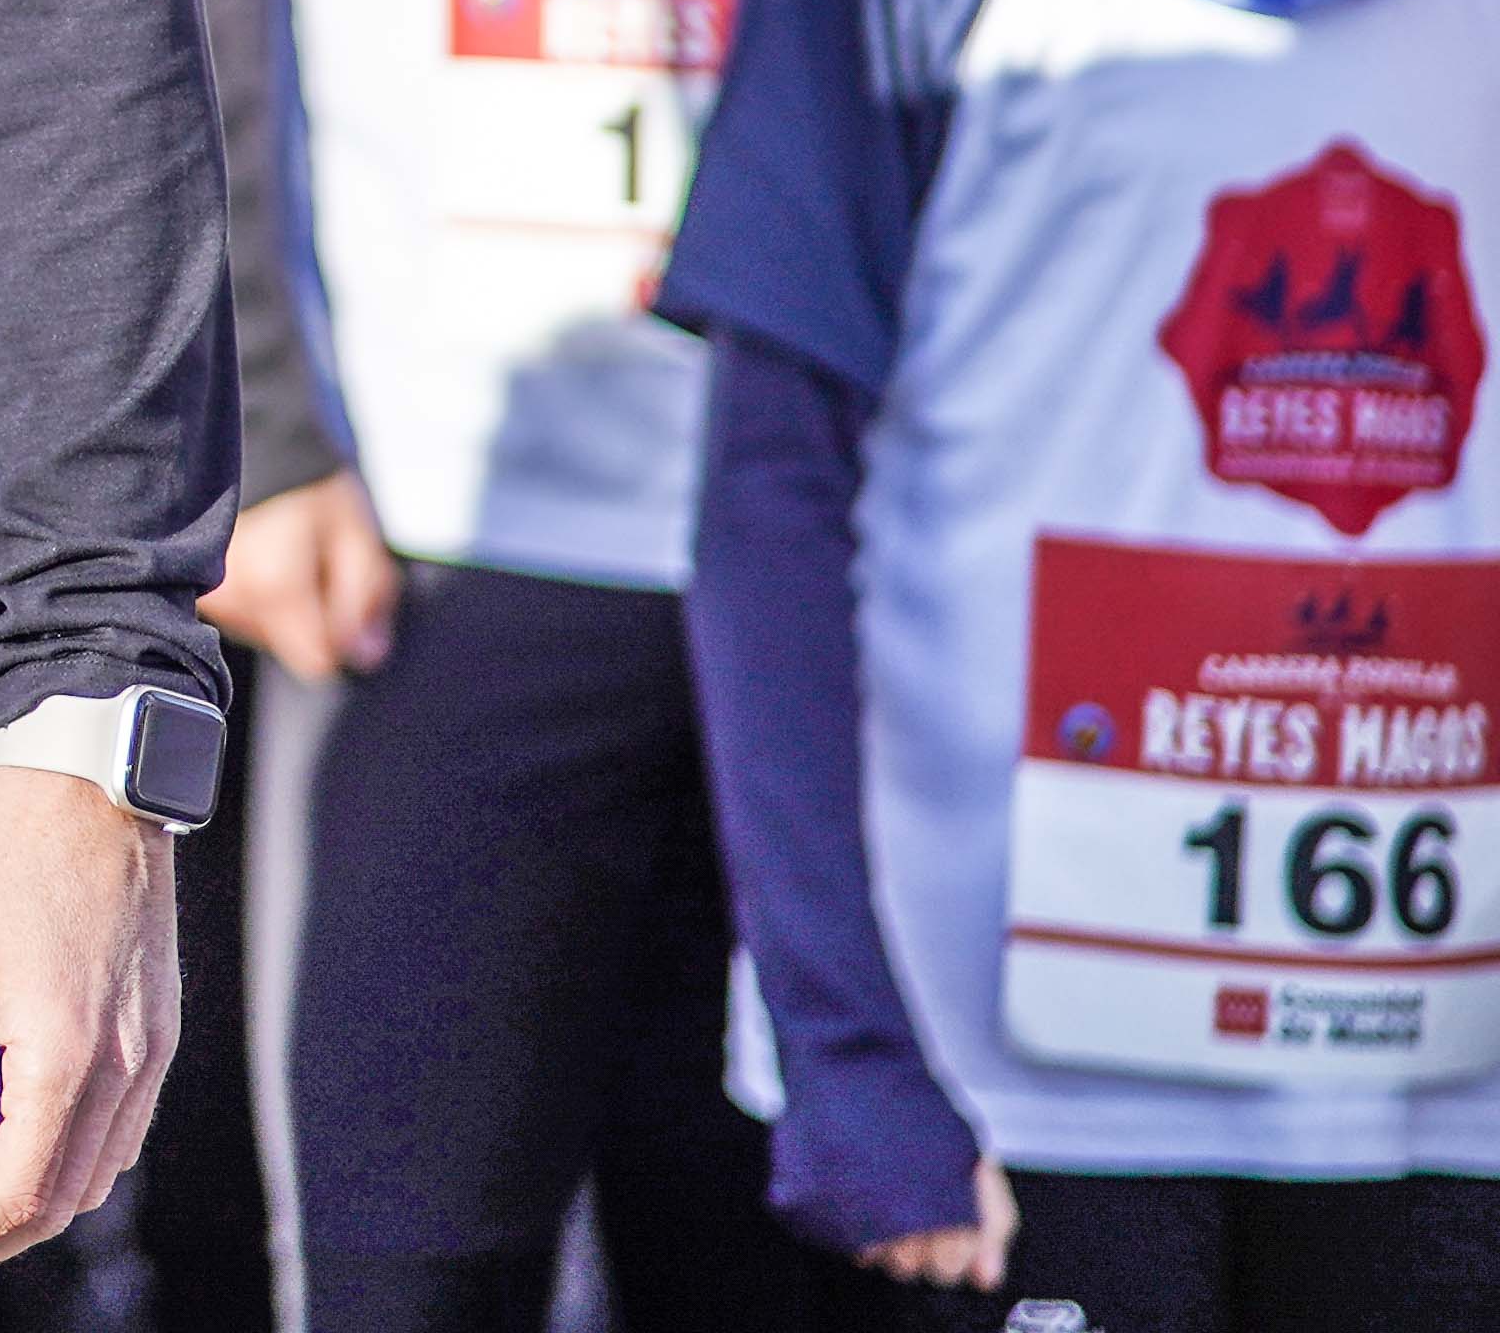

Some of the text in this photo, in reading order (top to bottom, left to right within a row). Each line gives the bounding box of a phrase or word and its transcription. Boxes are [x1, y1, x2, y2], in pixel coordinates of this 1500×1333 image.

[1143, 687, 1488, 786] REYES MAGOS
[1182, 800, 1457, 939] 166
